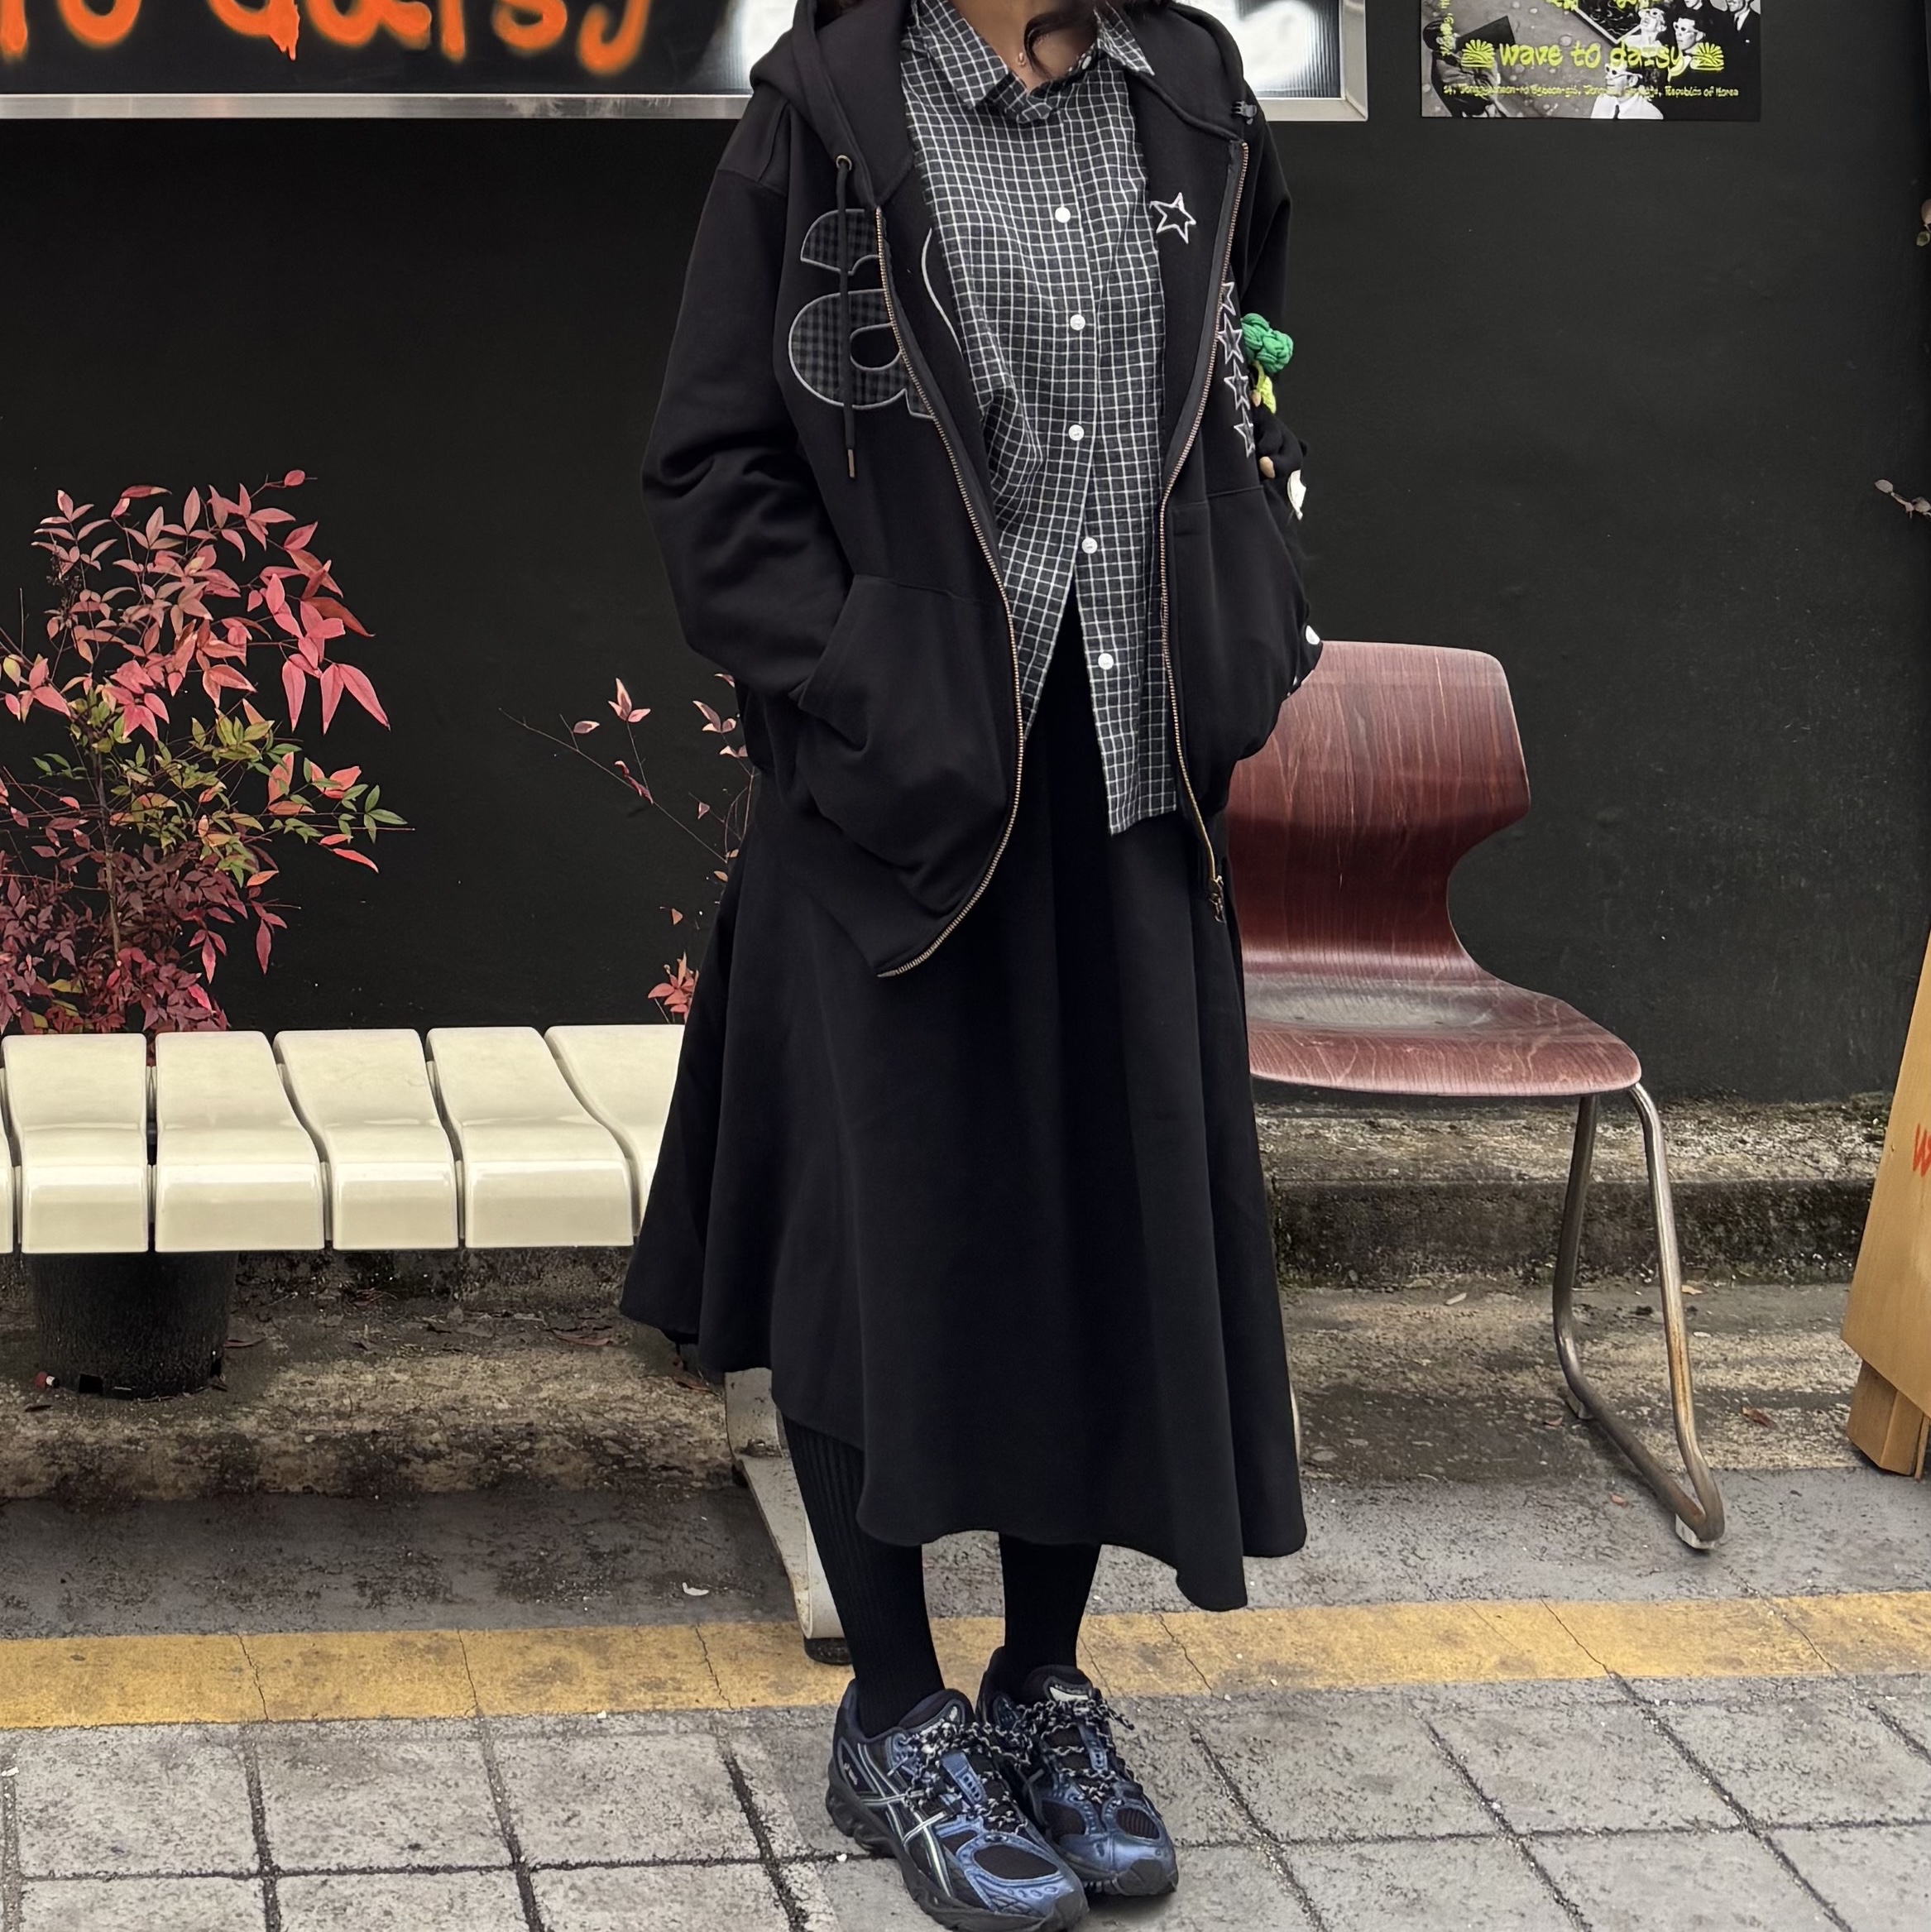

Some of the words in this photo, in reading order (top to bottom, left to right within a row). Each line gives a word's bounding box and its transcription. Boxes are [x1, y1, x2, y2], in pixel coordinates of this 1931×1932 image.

[1499, 42, 1564, 68] wave
[1570, 41, 1602, 68] to
[1610, 41, 1683, 73] daisy
[1703, 85, 1714, 97] of
[1716, 86, 1740, 97] Korea
